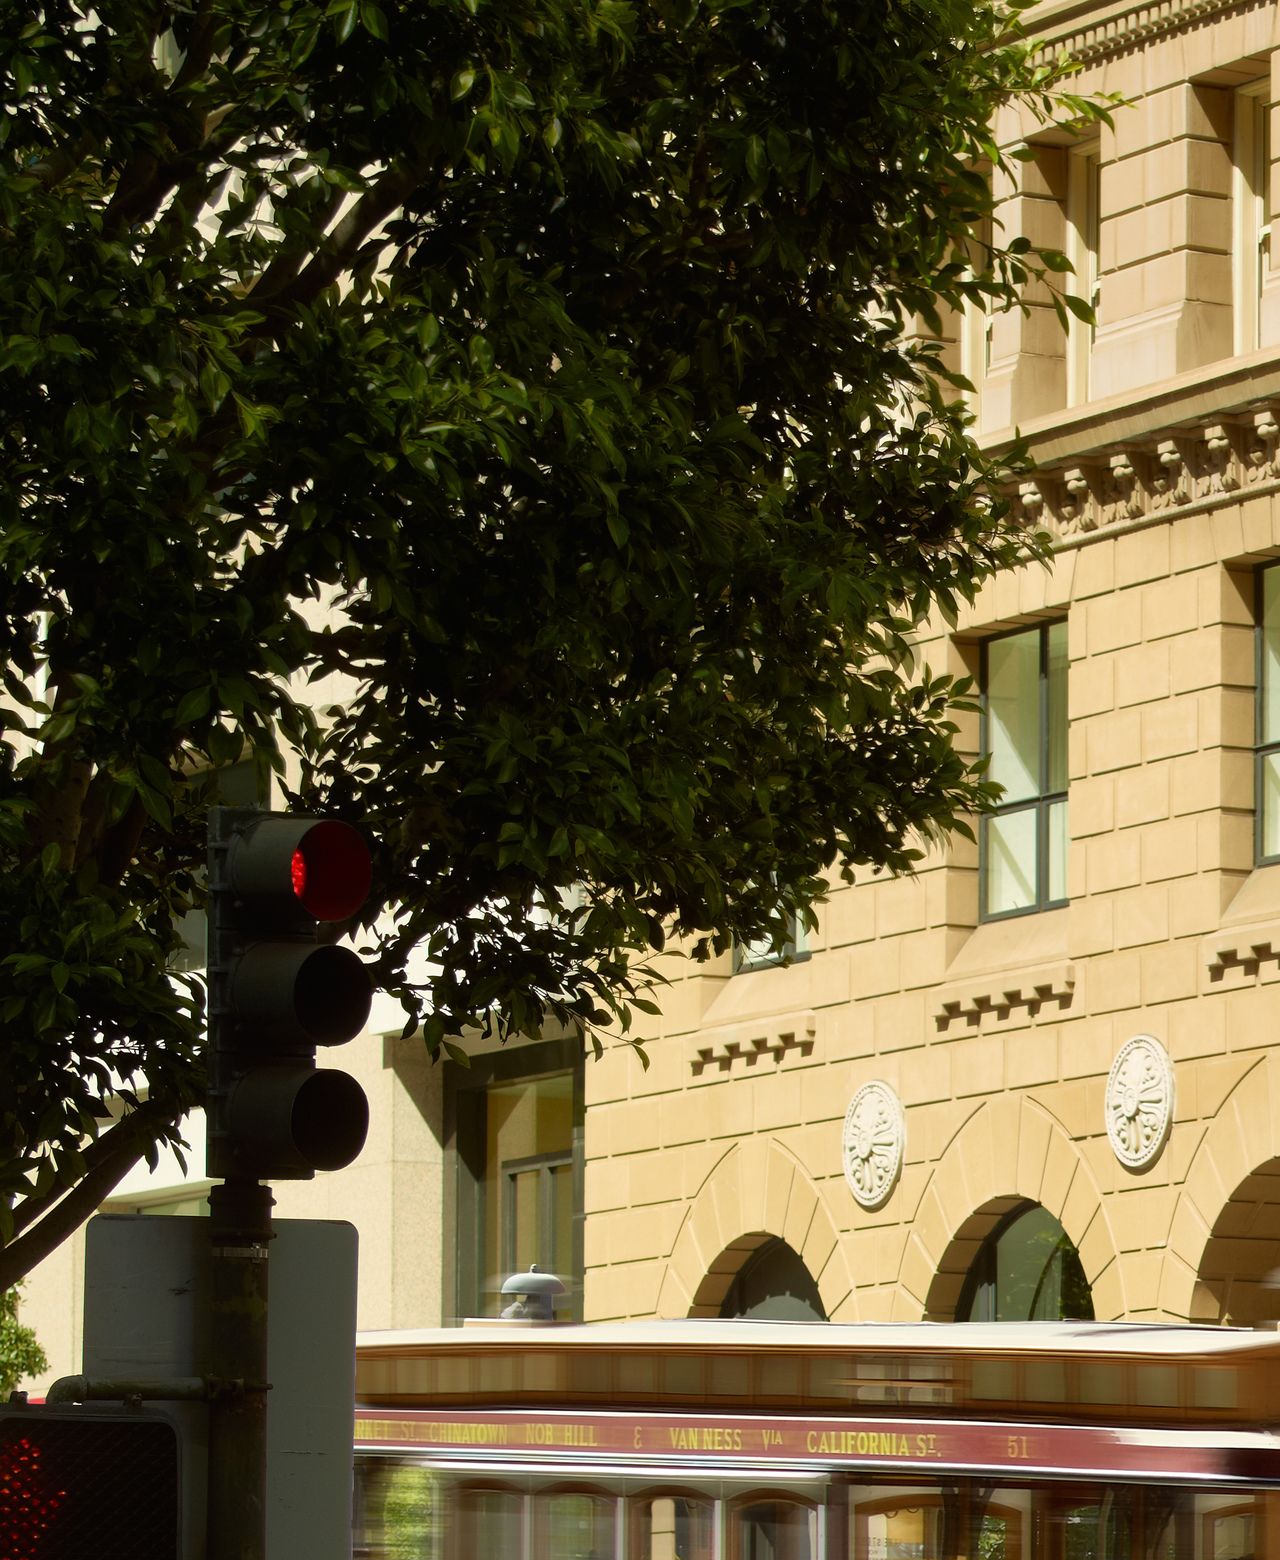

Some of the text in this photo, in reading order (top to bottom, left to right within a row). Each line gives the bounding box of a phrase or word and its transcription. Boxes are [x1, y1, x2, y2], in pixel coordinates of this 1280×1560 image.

[430, 1422, 508, 1446] CHINATOWN
[525, 1423, 554, 1445] NOB
[564, 1425, 599, 1447] HILL
[670, 1427, 699, 1450] VAN
[702, 1429, 743, 1452] NESS
[761, 1428, 784, 1451] VIA
[805, 1430, 910, 1457] CALIFORNIA
[1006, 1435, 1030, 1459] 51
